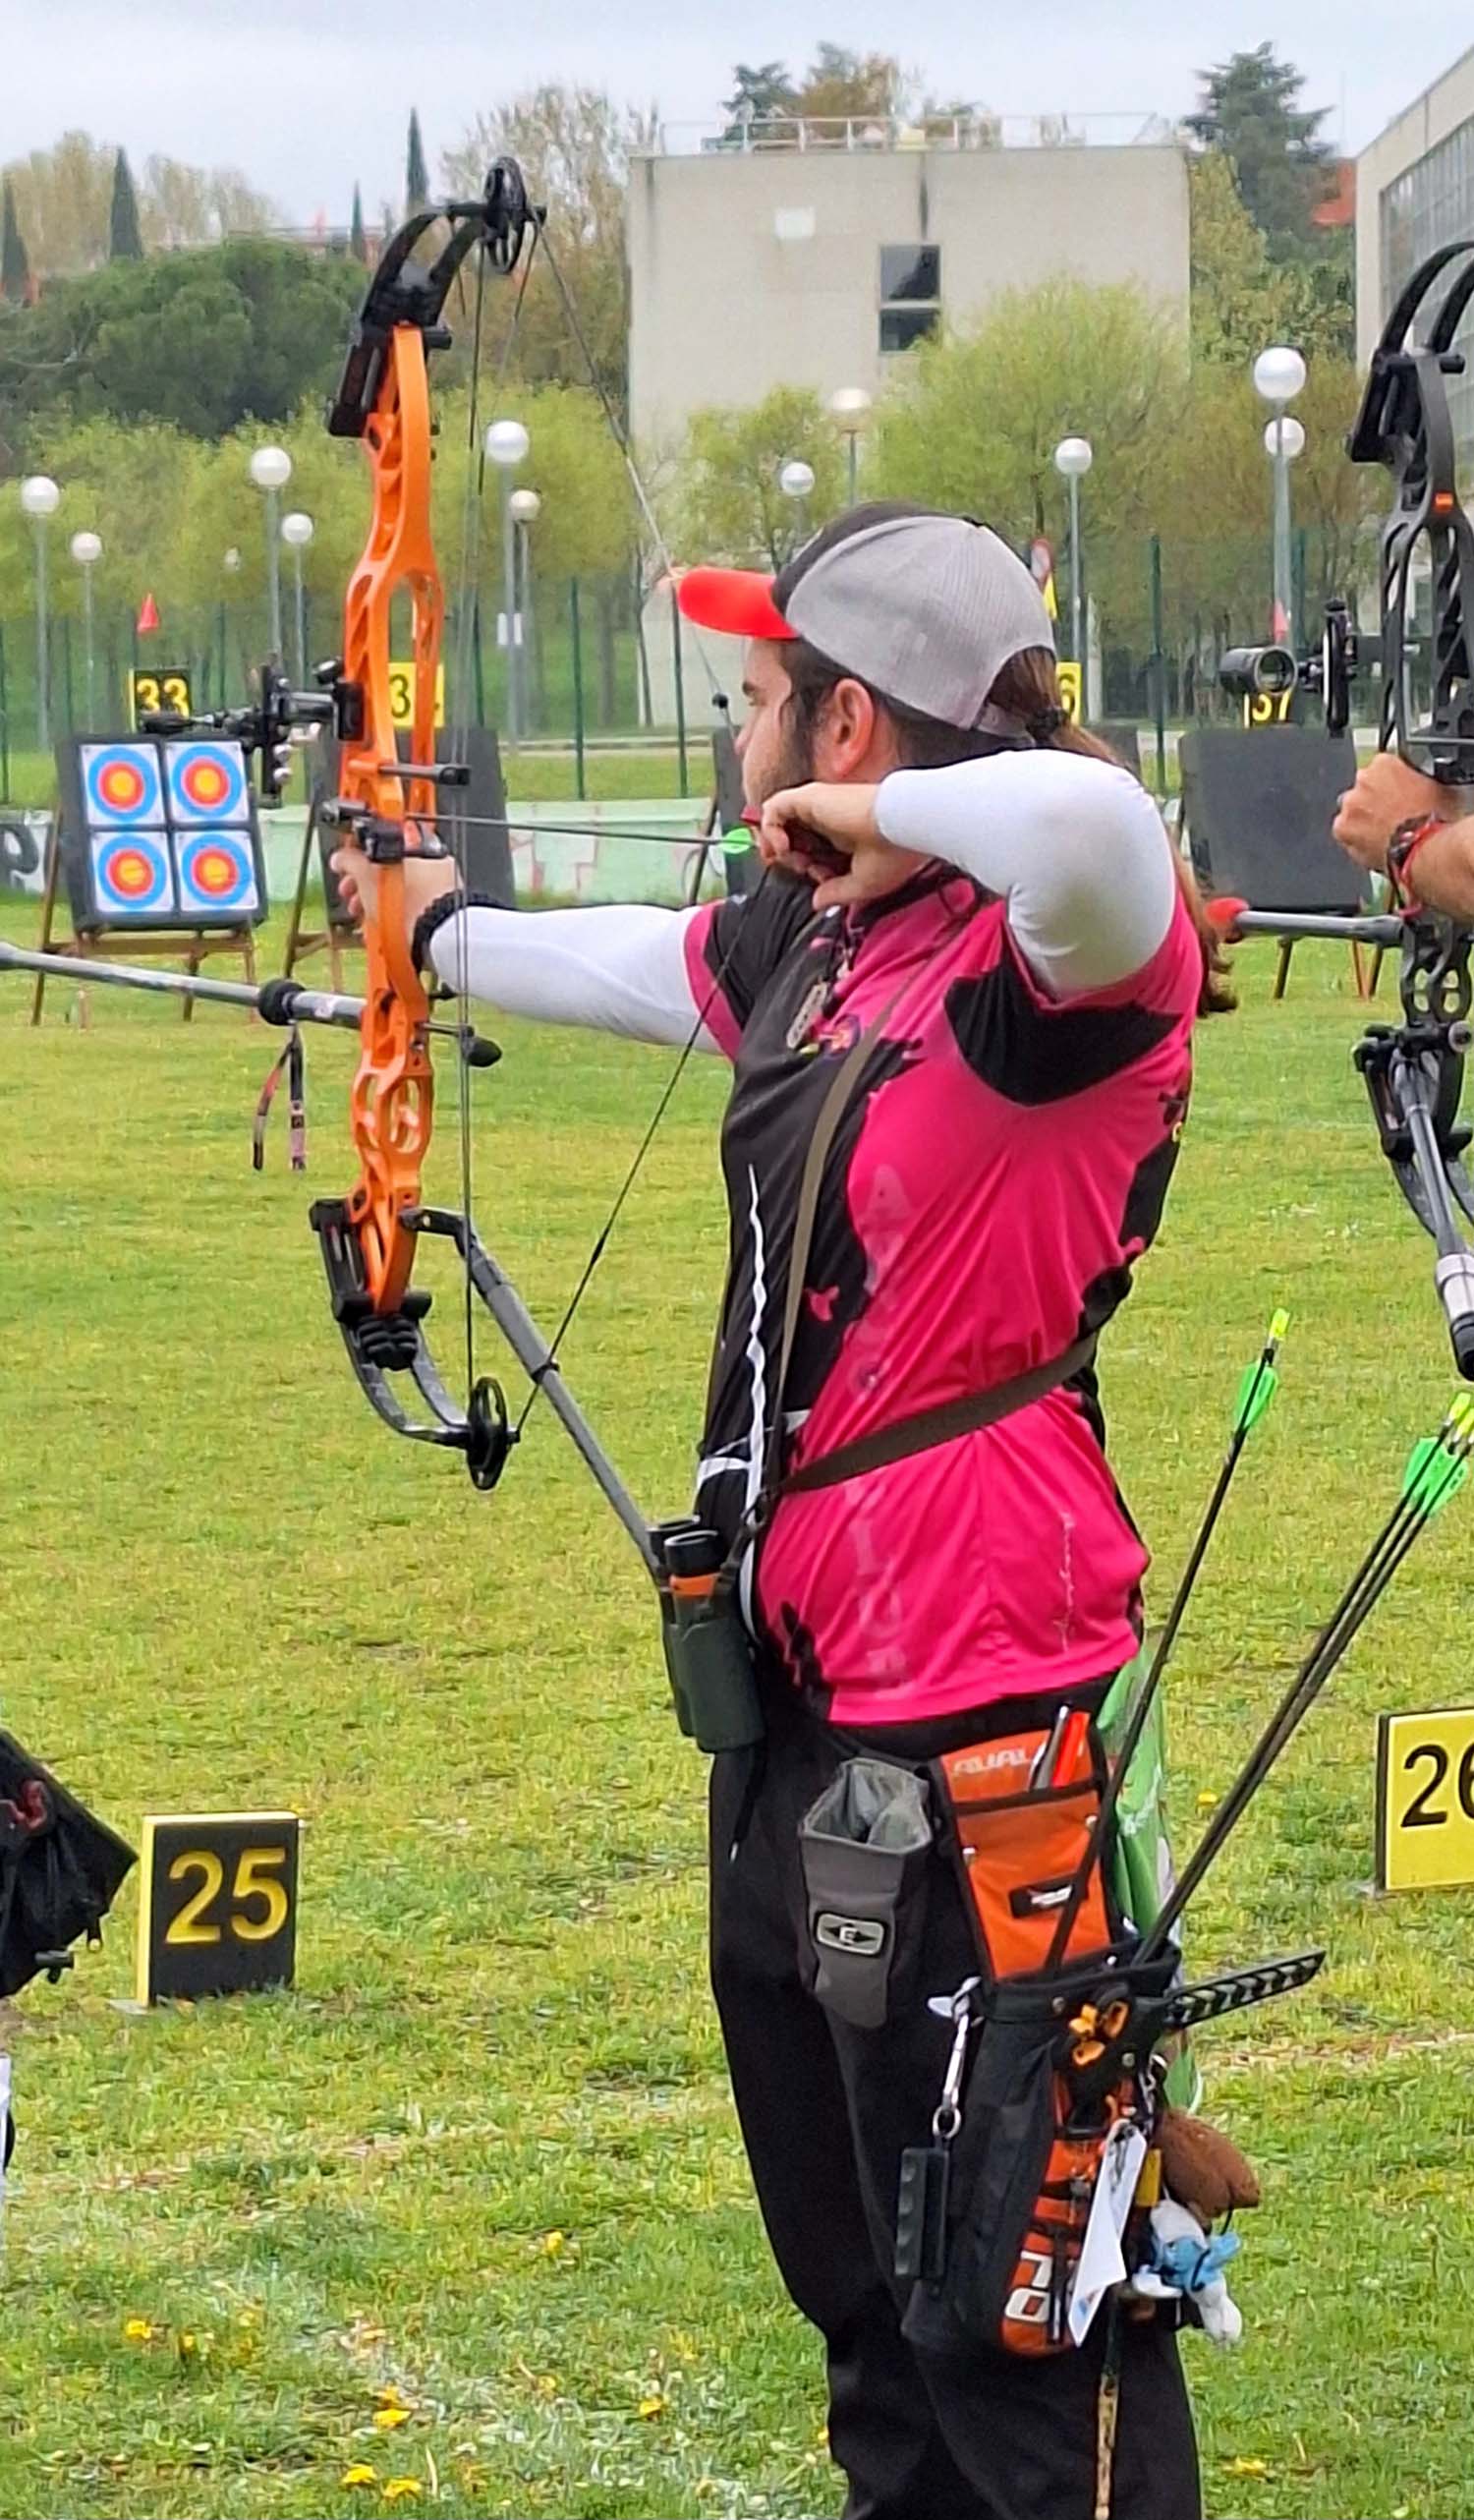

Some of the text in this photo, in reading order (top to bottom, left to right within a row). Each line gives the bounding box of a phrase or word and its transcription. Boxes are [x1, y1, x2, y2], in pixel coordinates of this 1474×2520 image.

[137, 677, 188, 718] 33
[1057, 672, 1077, 717] 6
[165, 1847, 288, 1944] 25
